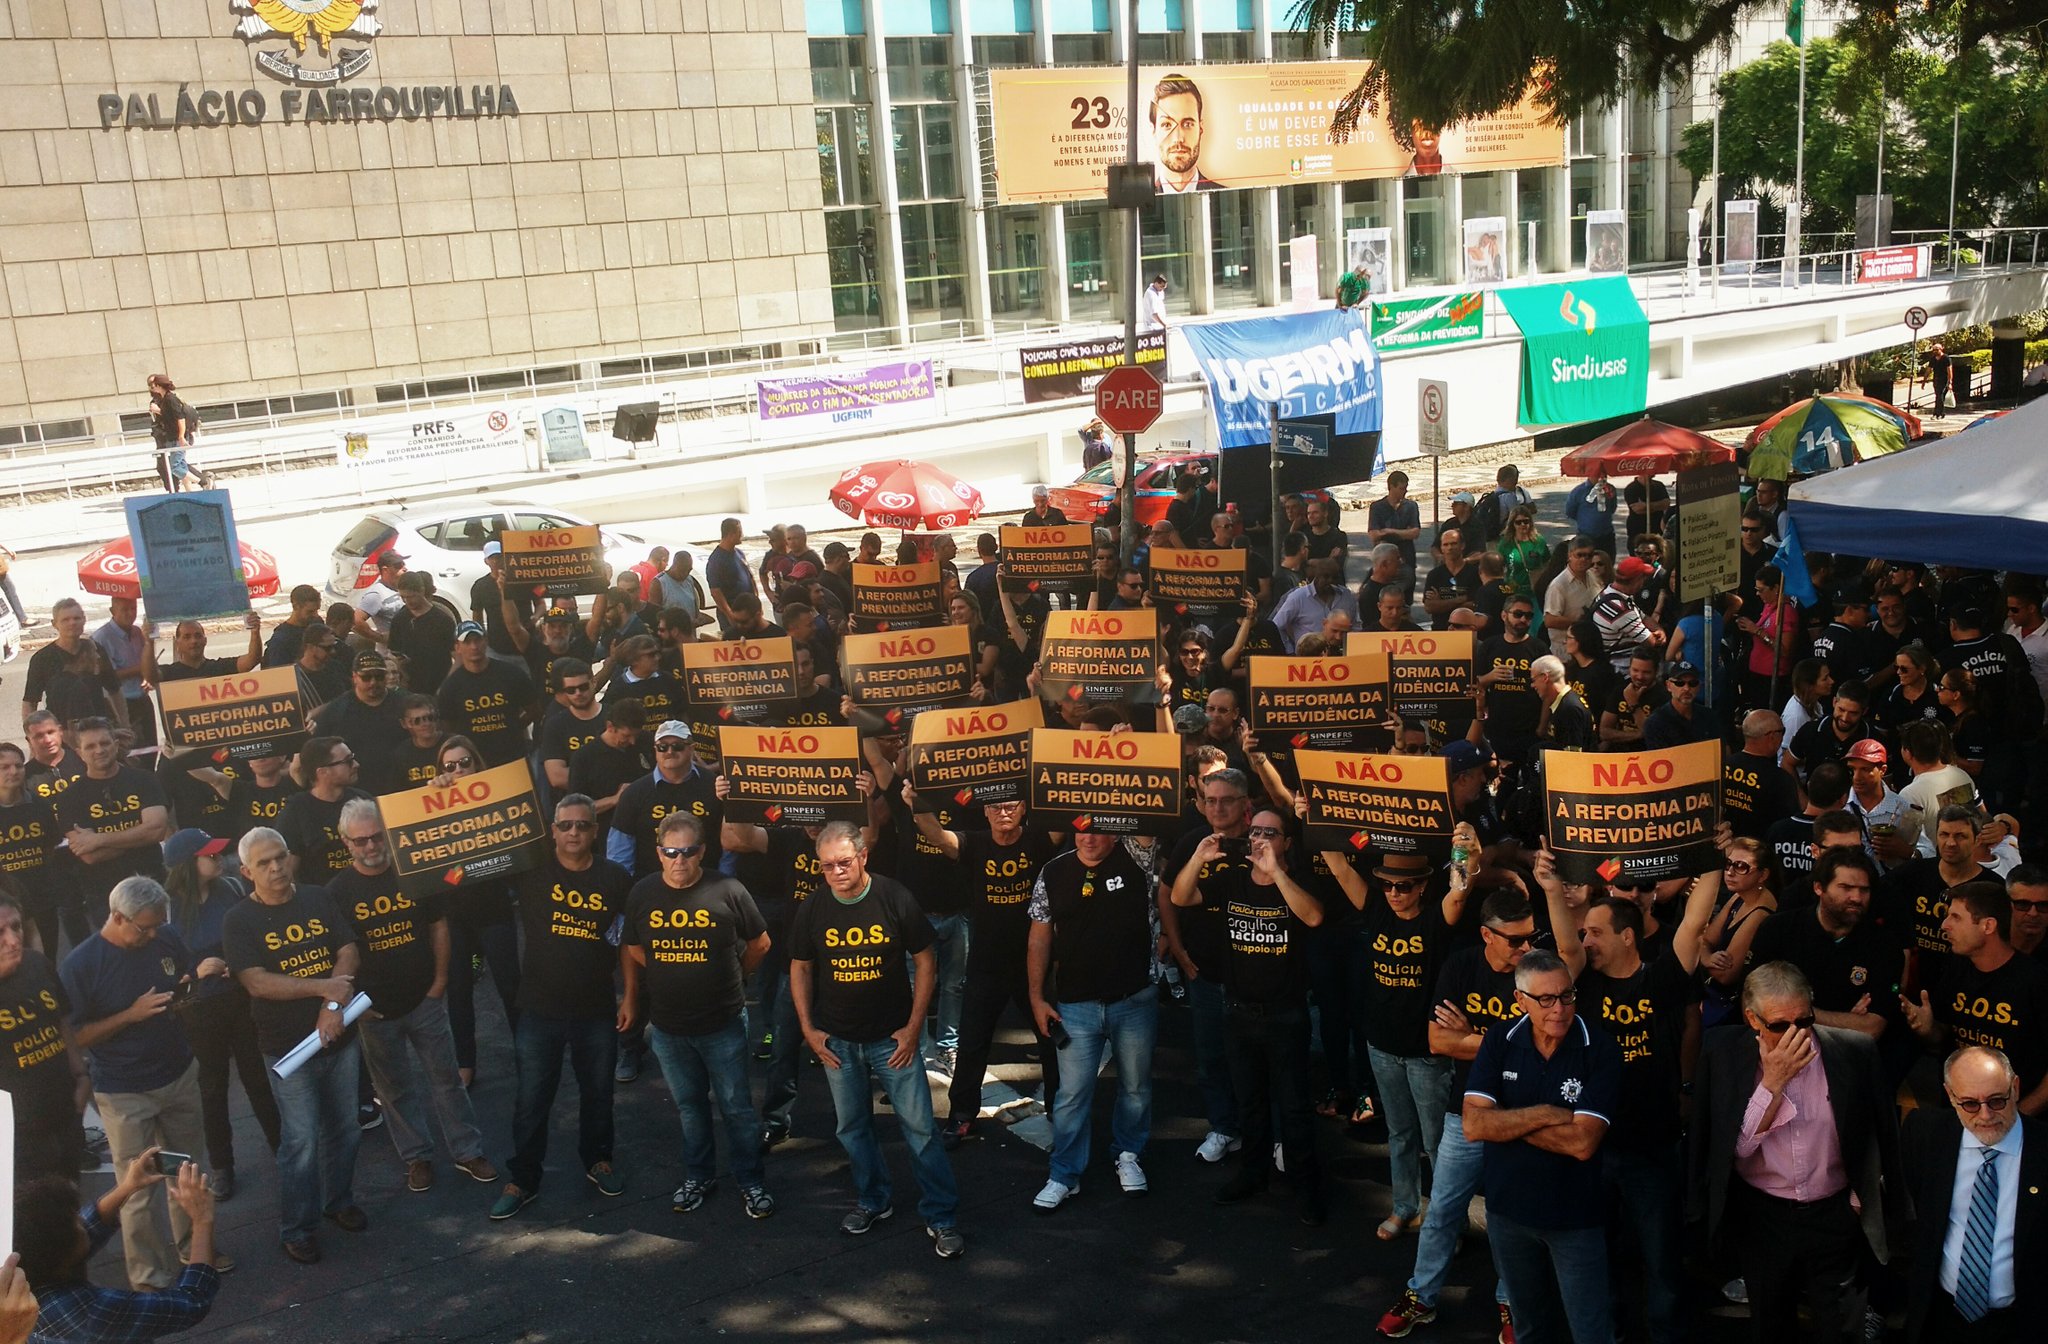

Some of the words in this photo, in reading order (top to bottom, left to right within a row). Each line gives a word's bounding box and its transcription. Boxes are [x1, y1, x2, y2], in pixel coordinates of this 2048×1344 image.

[300, 70, 337, 80] IGUALDADE
[98, 82, 266, 132] PALÁCIO
[280, 84, 520, 126] FARROUPILHA
[1240, 100, 1303, 113] IGUALDADE
[1309, 100, 1322, 111] DE
[1245, 117, 1252, 131] É
[1260, 119, 1278, 130] UM
[1285, 116, 1326, 129] DEVER
[1065, 134, 1104, 142] DIFERENÇA
[1236, 135, 1280, 150] SOBRE
[1287, 134, 1318, 147] ESSE
[1085, 145, 1118, 153] SALÁRIOS
[1054, 158, 1083, 167] HOMENS
[1865, 265, 1880, 278] NÃO
[1887, 263, 1913, 275] DIREITO
[1437, 308, 1450, 318] DIZ
[1384, 332, 1419, 344] REFORMA
[1421, 331, 1431, 341] DA
[1432, 325, 1479, 339] PREVIDÊNCIA
[1080, 347, 1090, 356] DO
[1092, 345, 1104, 353] RIO
[1138, 339, 1148, 348] DO
[1150, 336, 1164, 347] SUL
[1024, 363, 1058, 378] CONTRA
[1060, 362, 1066, 373] A
[1067, 357, 1103, 371] REFORMA
[1105, 356, 1115, 367] DA
[768, 390, 808, 401] MULHERES
[823, 382, 867, 396] SEGURANÇA
[870, 378, 898, 390] PÚBLICA
[1224, 372, 1376, 421] SINDICATO
[768, 402, 809, 416] CONTRA
[812, 400, 819, 409] O
[823, 397, 839, 410] FIM
[842, 396, 854, 406] DA
[857, 386, 929, 405] APOSENTADORIA
[1102, 390, 1158, 409] PARE
[832, 409, 872, 423] UGEIRM
[413, 421, 454, 437] PRFS
[387, 445, 422, 455] REFORMA
[406, 447, 464, 460] TRABALHADORES
[466, 440, 519, 451] BRASILEIROS
[873, 513, 911, 527] KIBON
[96, 581, 126, 593] KIBON
[1070, 614, 1122, 635] NÃO
[714, 643, 761, 662] NÃO
[1046, 643, 1054, 656] À
[1058, 646, 1126, 658] REFORMA
[1131, 647, 1150, 658] DA
[1381, 634, 1436, 655] NÃO
[1050, 661, 1144, 674] PREVIDÊNCIA
[1962, 651, 2007, 670] POLÍCIA
[692, 672, 700, 684] À
[704, 670, 767, 683] REFORMA
[771, 669, 789, 679] DA
[1288, 660, 1350, 682] NÃO
[1445, 667, 1466, 677] DA
[1973, 666, 2003, 677] CIVIL
[199, 678, 259, 701] NÃO
[699, 682, 785, 698] PREVIDÊNCIA
[1258, 692, 1269, 706] À
[1274, 693, 1354, 706] REFORMA
[1360, 691, 1382, 703] DA
[465, 693, 508, 711] S.O.S.
[175, 714, 185, 728] À
[189, 704, 269, 726] REFORMA
[272, 700, 294, 713] DA
[946, 711, 1008, 736] NÃO
[1266, 707, 1376, 723] PREVIDÊNCIA
[184, 717, 291, 743] PREVIDÊNCIA
[758, 731, 819, 753] NÃO
[1073, 735, 1138, 760] NÃO
[919, 748, 930, 764] À
[934, 742, 1015, 763] REFORMA
[732, 761, 742, 775] À
[747, 765, 825, 778] REFORMA
[830, 767, 853, 778] DA
[1039, 768, 1051, 784] À
[1057, 772, 1142, 787] REFORMA
[1148, 775, 1172, 789] DA
[1336, 757, 1403, 783] NÃO
[1593, 756, 1674, 786] NÃO
[422, 781, 491, 814] NÃO
[740, 781, 848, 795] PREVIDÊNCIA
[1048, 789, 1164, 807] PREVIDÊNCIA
[1312, 784, 1323, 799] À
[1326, 789, 1413, 809] REFORMA
[1417, 799, 1443, 812] DA
[1556, 797, 1569, 818] À
[1575, 799, 1680, 820] REFORMA
[1686, 792, 1713, 811] DA
[400, 831, 412, 848] À
[415, 812, 504, 844] REFORMA
[507, 802, 532, 820] DA
[1322, 804, 1439, 828] PREVIDÊNCIA
[1566, 818, 1703, 843] PREVIDÊNCIA
[410, 823, 531, 864] PREVIDÊNCIA
[986, 879, 1031, 894] POLÍCIA
[1106, 875, 1124, 891] 62
[355, 892, 416, 920] S.O.S.
[650, 909, 716, 928] S.O.S.
[1228, 918, 1277, 932] orgulho
[265, 919, 329, 950] S.O.S.
[367, 919, 413, 939] POLÍCIA
[825, 925, 889, 947] S.O.S.
[370, 932, 415, 952] FEDERAL
[652, 937, 708, 949] POLÍCIA
[281, 946, 330, 970] POLÍCIA
[655, 952, 707, 962] FEDERAL
[831, 955, 881, 969] POLÍCIA
[833, 970, 883, 981] FEDERAL
[1374, 961, 1422, 974] POLÍCIA
[1374, 973, 1422, 987] FEDERAL
[1952, 992, 2018, 1026] S.O.S.
